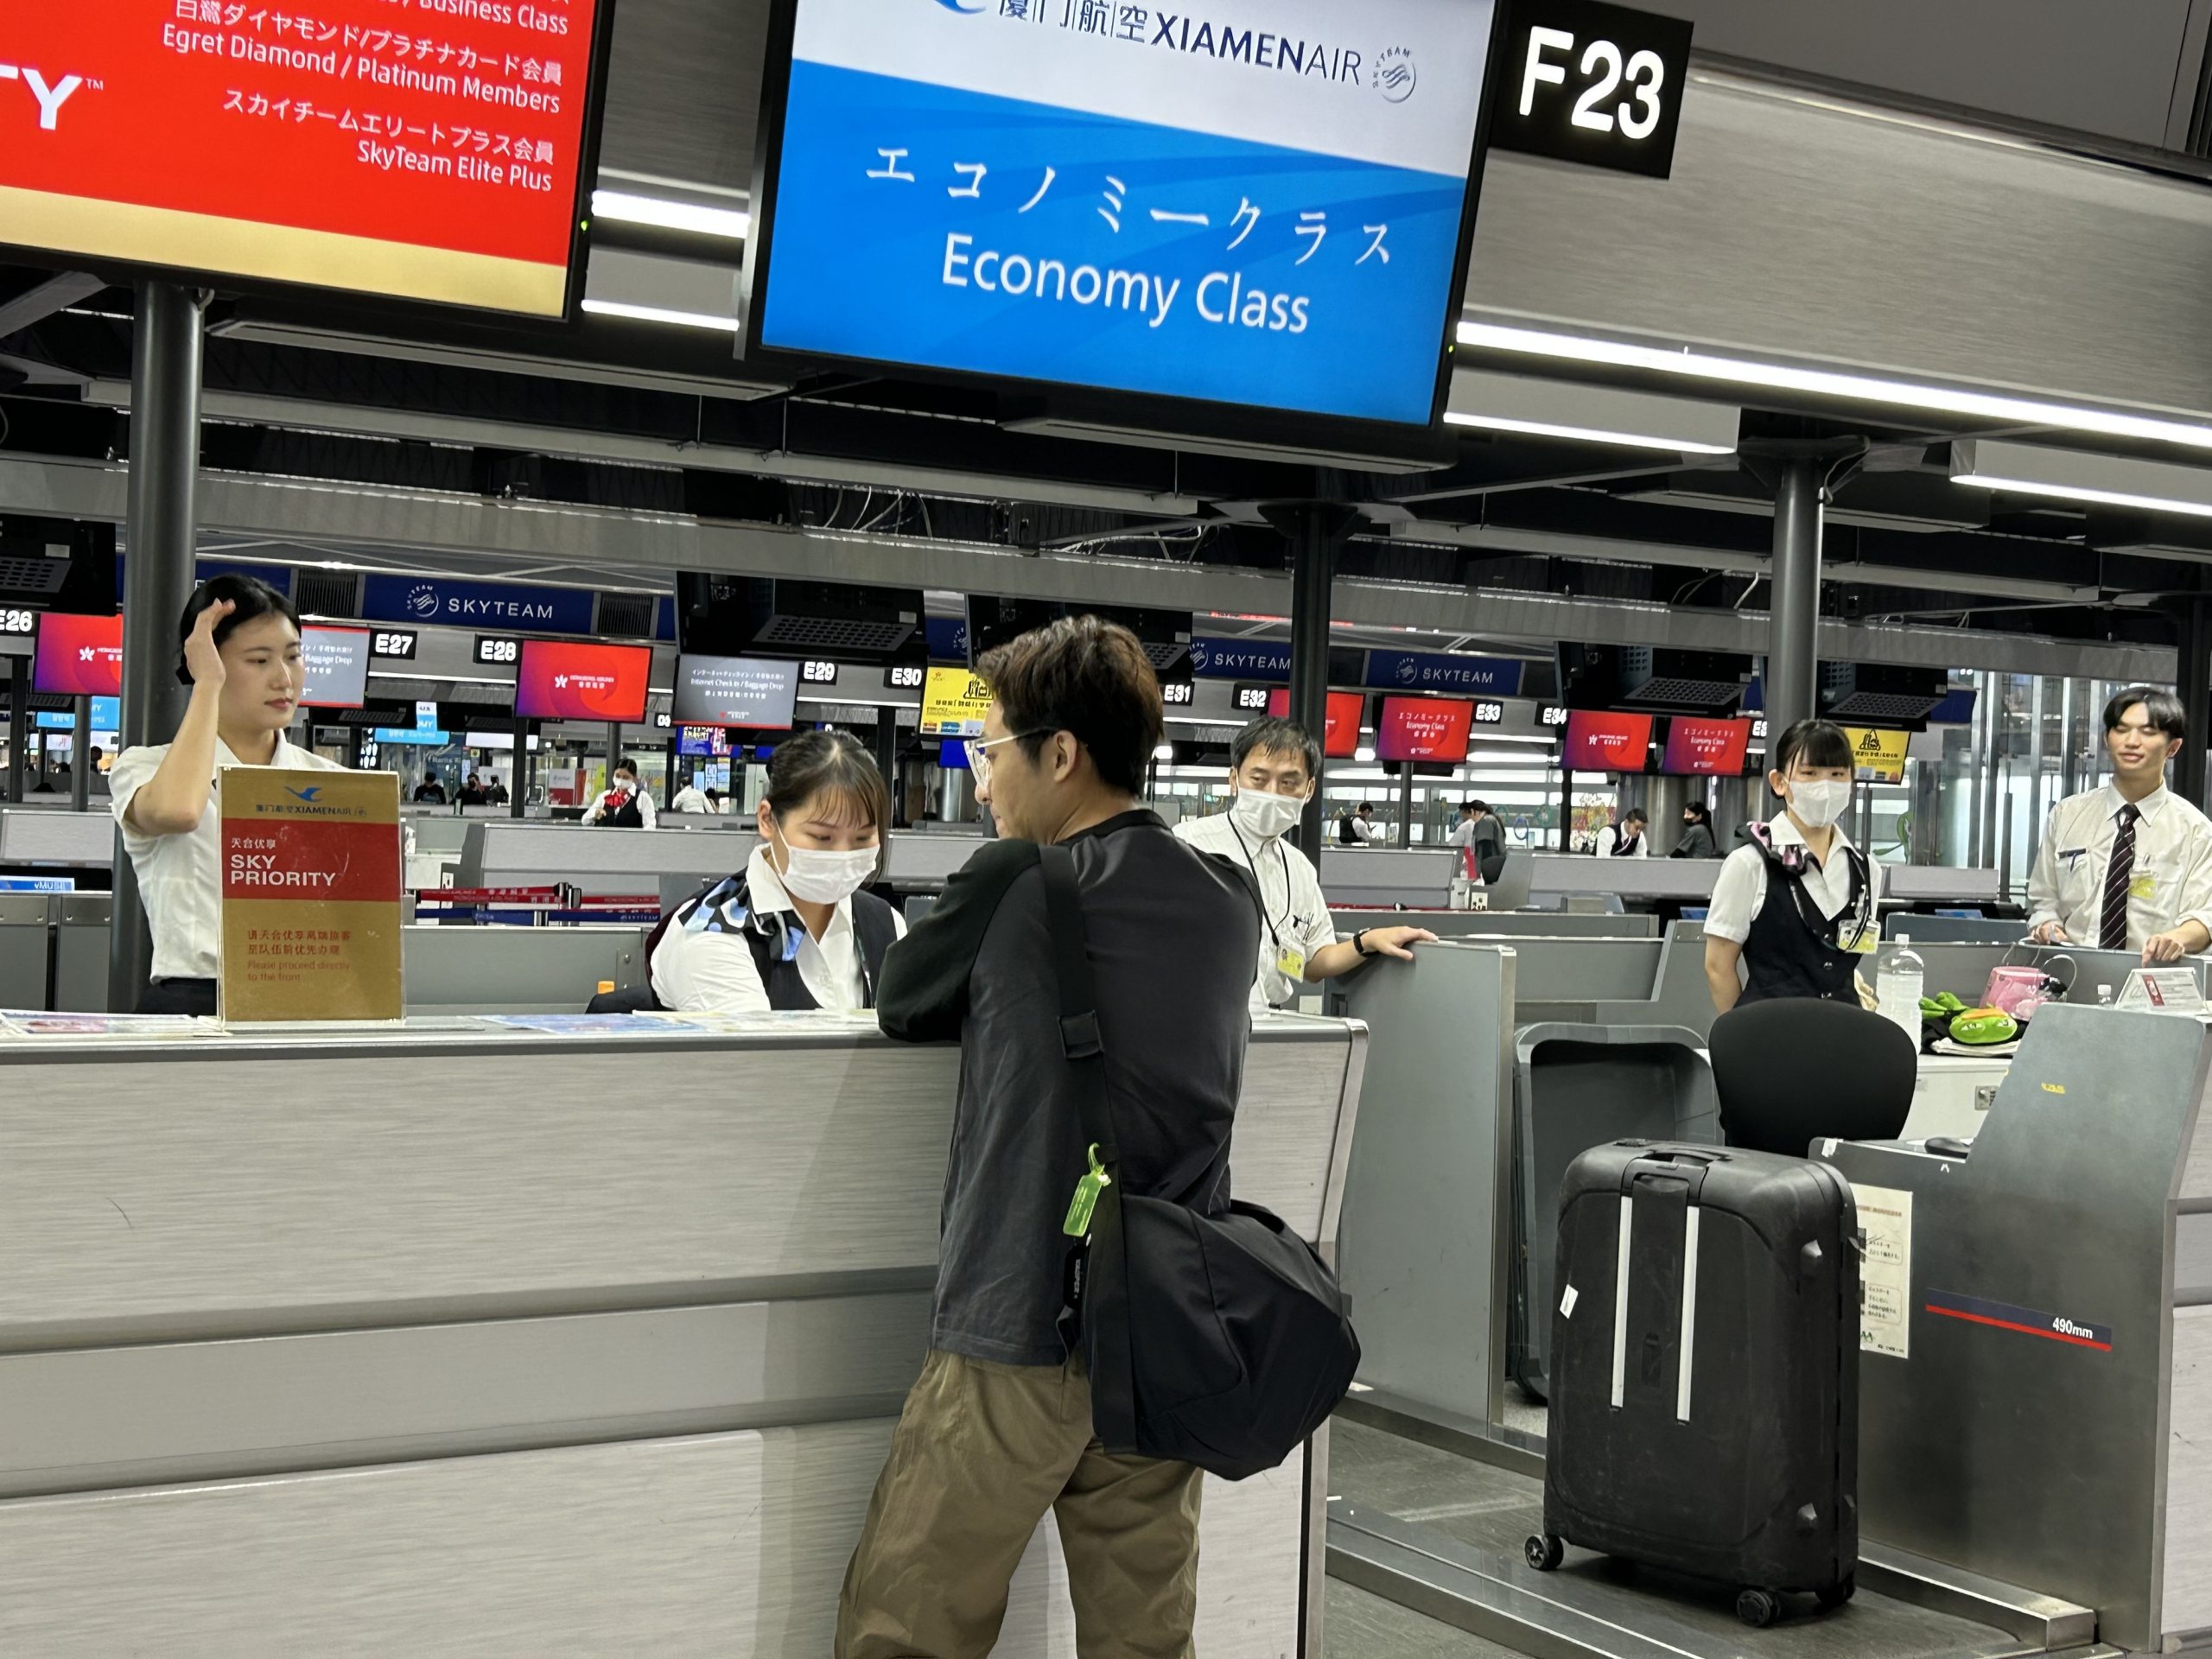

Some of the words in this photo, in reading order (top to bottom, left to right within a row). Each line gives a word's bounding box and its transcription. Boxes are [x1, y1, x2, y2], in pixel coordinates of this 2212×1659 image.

[518, 4, 568, 35] Class
[1150, 10, 1361, 86] XIAMENAIR
[163, 23, 224, 55] Egret
[231, 35, 336, 74] Diamond
[358, 57, 456, 96] Platinum
[462, 76, 560, 113] Members
[1519, 26, 1664, 139] F23
[223, 89, 554, 165] スカイチームエリートプラス会員
[357, 140, 451, 176] SkyTeam
[457, 156, 504, 184] Elite
[509, 164, 552, 192] Plus
[866, 147, 1390, 265] エコノミークラス
[943, 232, 1180, 327] Economy
[1196, 271, 1310, 333] Class
[448, 598, 553, 619] SKYTEAM
[375, 633, 413, 655] E27
[480, 640, 517, 661] E28
[804, 661, 836, 682] E29
[1215, 653, 1291, 670] SKYTEAM
[891, 667, 922, 686] E30
[1422, 667, 1494, 683] SKYTEAM
[1164, 684, 1191, 702] E31
[1239, 690, 1267, 708] E32
[1475, 703, 1501, 721] E33
[1542, 707, 1567, 725] E34
[231, 854, 276, 869] SKY
[231, 870, 336, 887] PRIORITY
[248, 960, 276, 969] Please
[279, 960, 315, 971] proceed
[248, 973, 257, 982] to
[260, 973, 276, 982] the
[2052, 1317, 2093, 1340] 490mm
